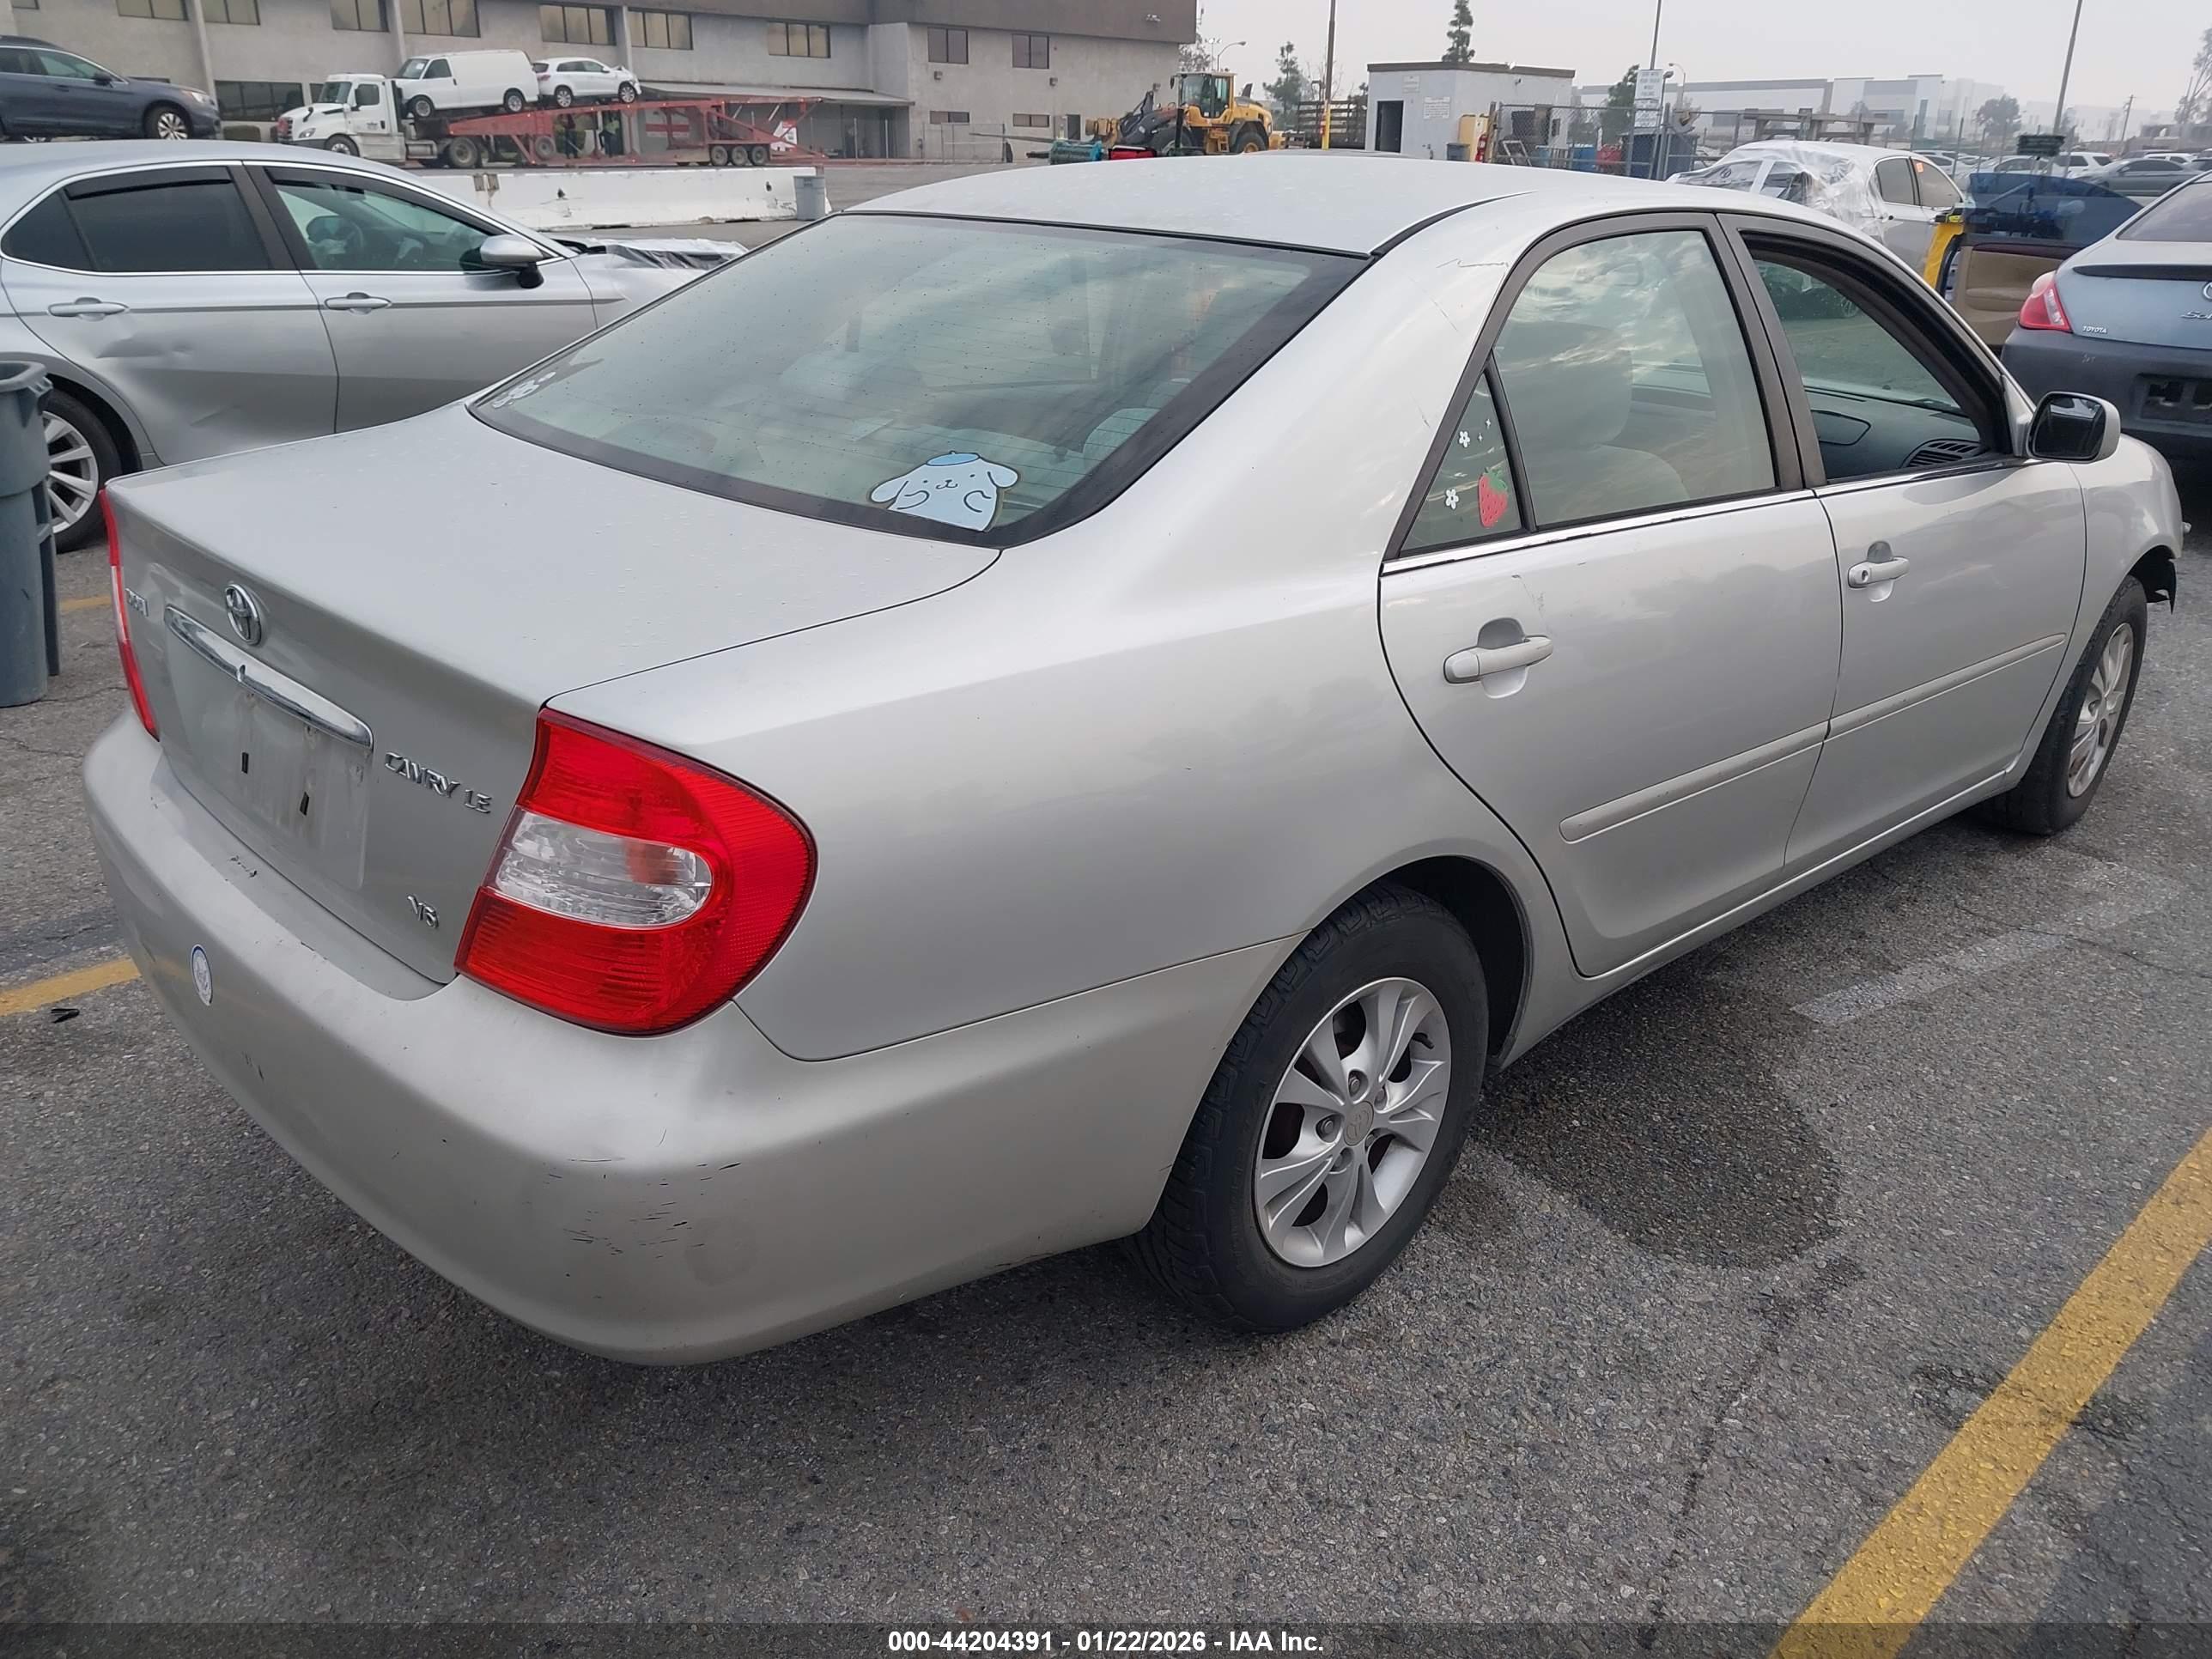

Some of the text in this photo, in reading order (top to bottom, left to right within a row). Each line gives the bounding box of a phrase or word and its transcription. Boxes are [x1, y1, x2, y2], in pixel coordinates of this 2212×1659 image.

[2081, 325, 2108, 335] TOYOTA
[385, 751, 493, 814] CAMRY LE
[407, 894, 439, 929] V6
